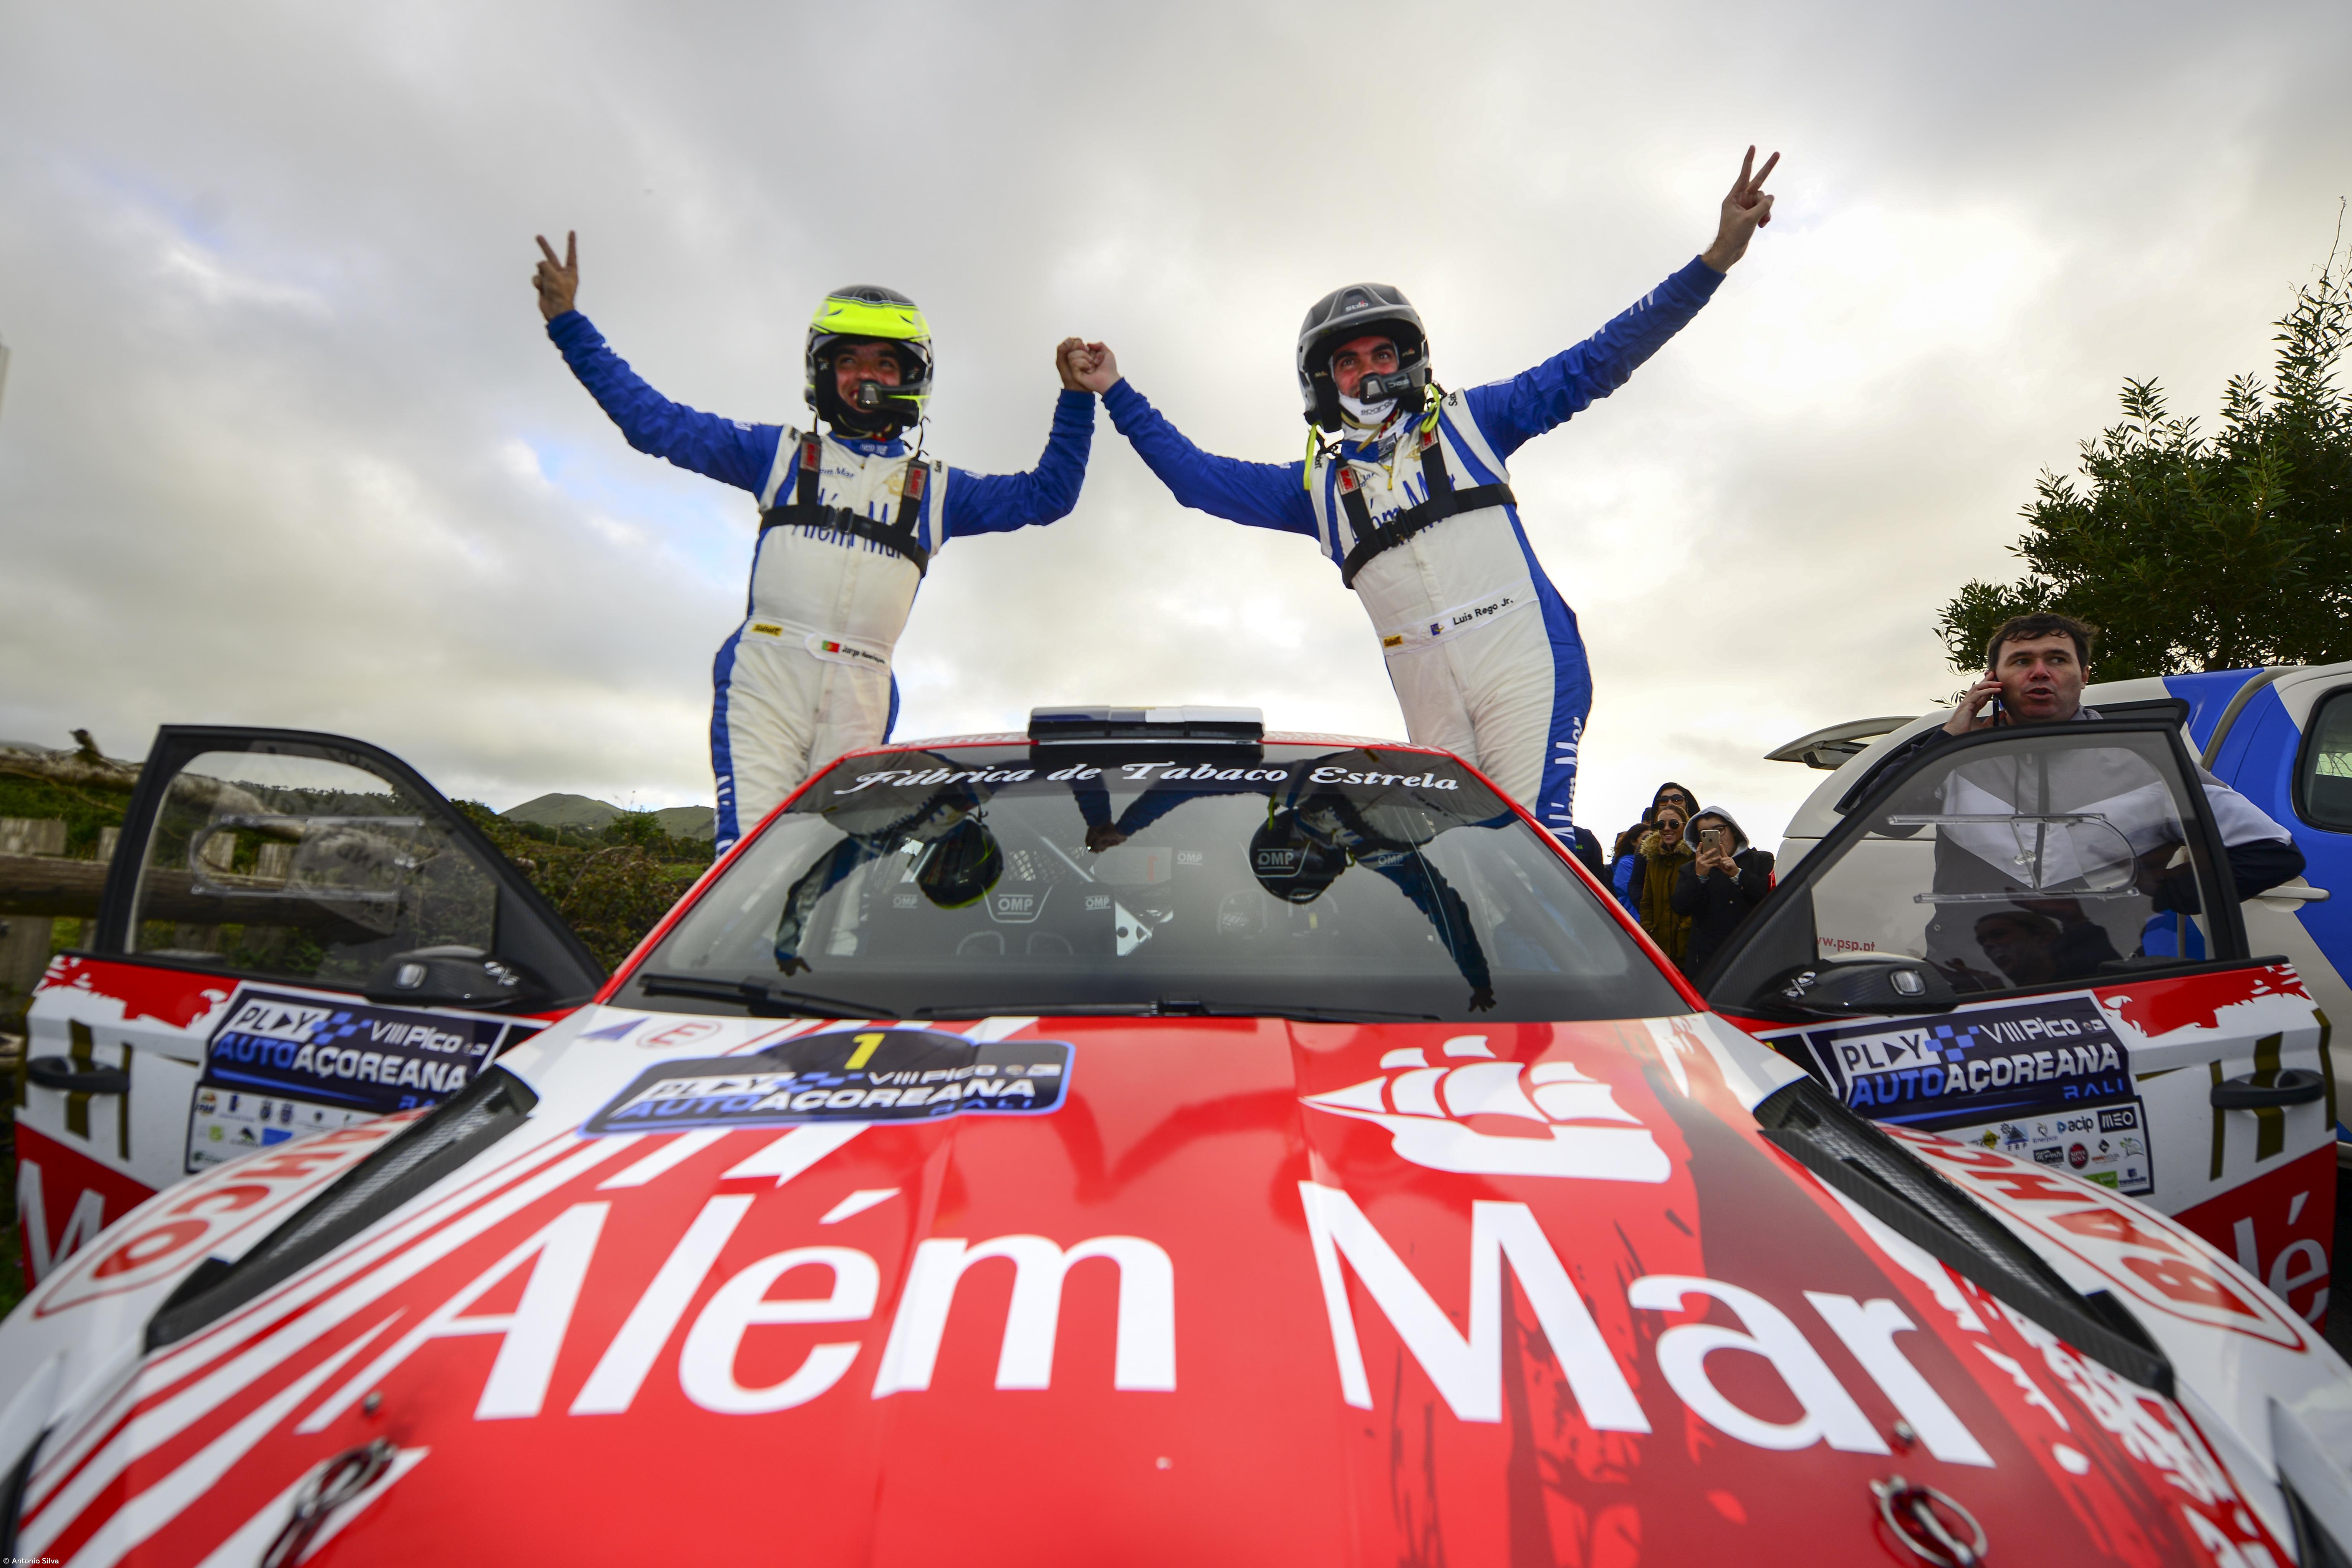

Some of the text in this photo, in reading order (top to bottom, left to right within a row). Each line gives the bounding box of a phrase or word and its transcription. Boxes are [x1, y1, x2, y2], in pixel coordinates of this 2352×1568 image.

[1453, 597, 1514, 626] Luis Rego Jr.
[834, 760, 1459, 795] Fábrica de Tabaco Estrela
[1177, 852, 1203, 864] OMP
[1258, 851, 1294, 866] OMP
[893, 896, 918, 907] OMP
[998, 897, 1033, 912] OMP
[1086, 897, 1111, 908] OMP
[844, 1033, 886, 1070] 1
[2062, 1078, 2124, 1099] RALI
[2068, 1116, 2094, 1133] acip
[2101, 1111, 2134, 1129] MEO
[2033, 1136, 2059, 1144] Enerpico
[293, 1181, 1996, 1468] Além Mar
